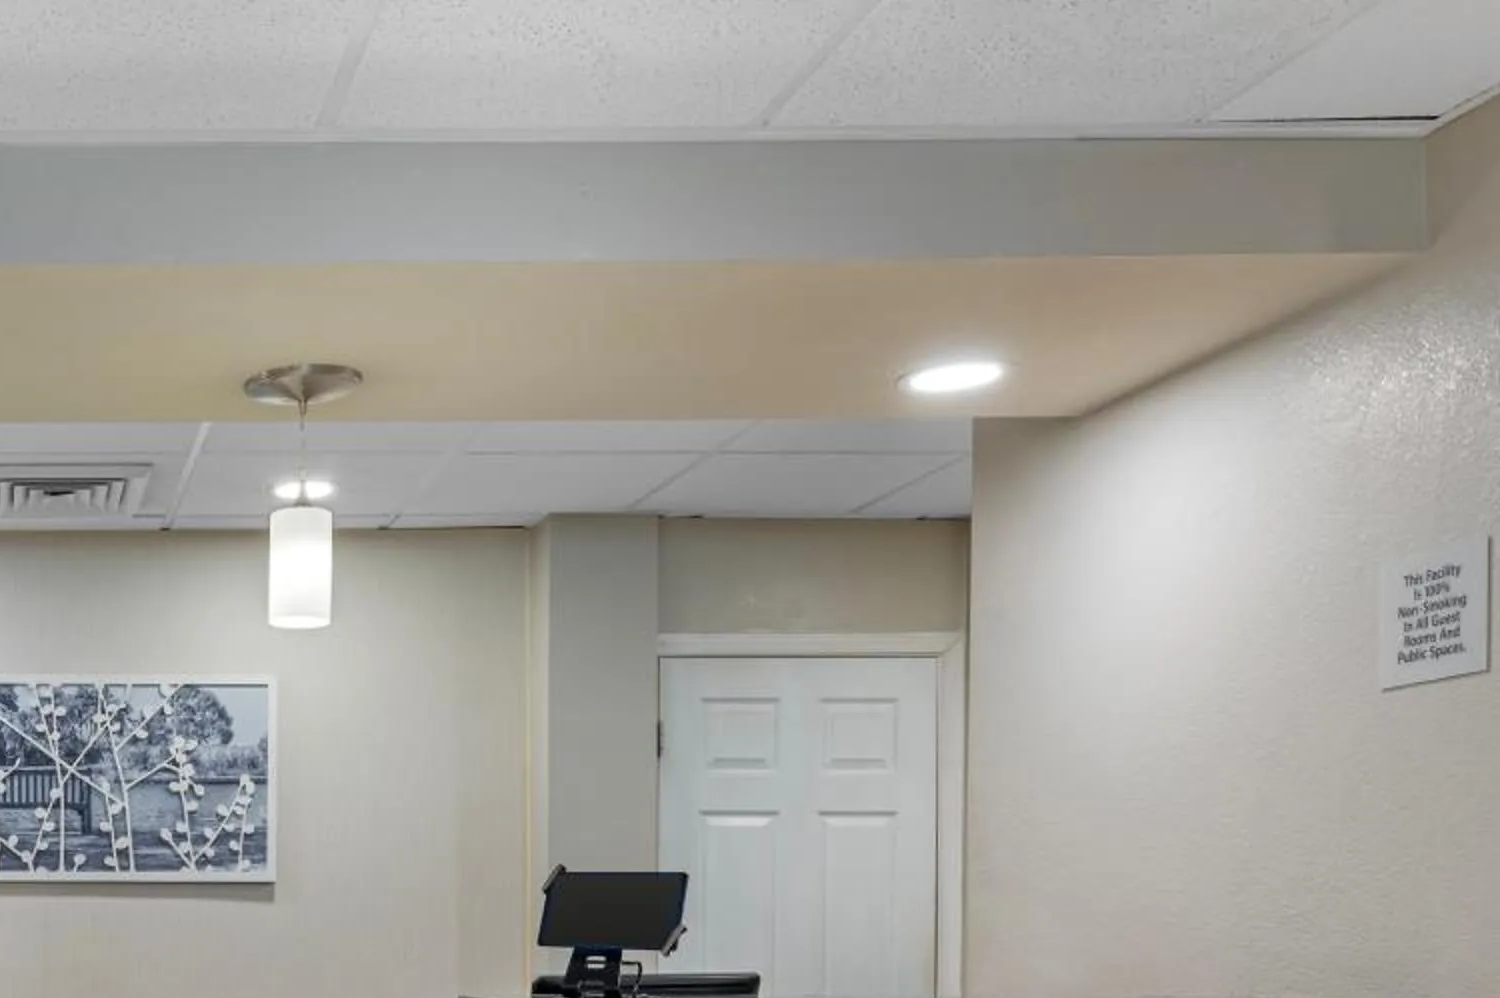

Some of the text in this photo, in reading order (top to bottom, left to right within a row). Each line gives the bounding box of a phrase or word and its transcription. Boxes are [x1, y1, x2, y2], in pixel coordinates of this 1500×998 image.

[1403, 564, 1462, 588] This Facility
[1413, 582, 1450, 601] Is 100%
[1397, 594, 1468, 619] Non-Smoking
[1403, 611, 1461, 633] In All Guest
[1403, 626, 1461, 648] Rooms And
[1397, 642, 1467, 666] Public Spaces.
